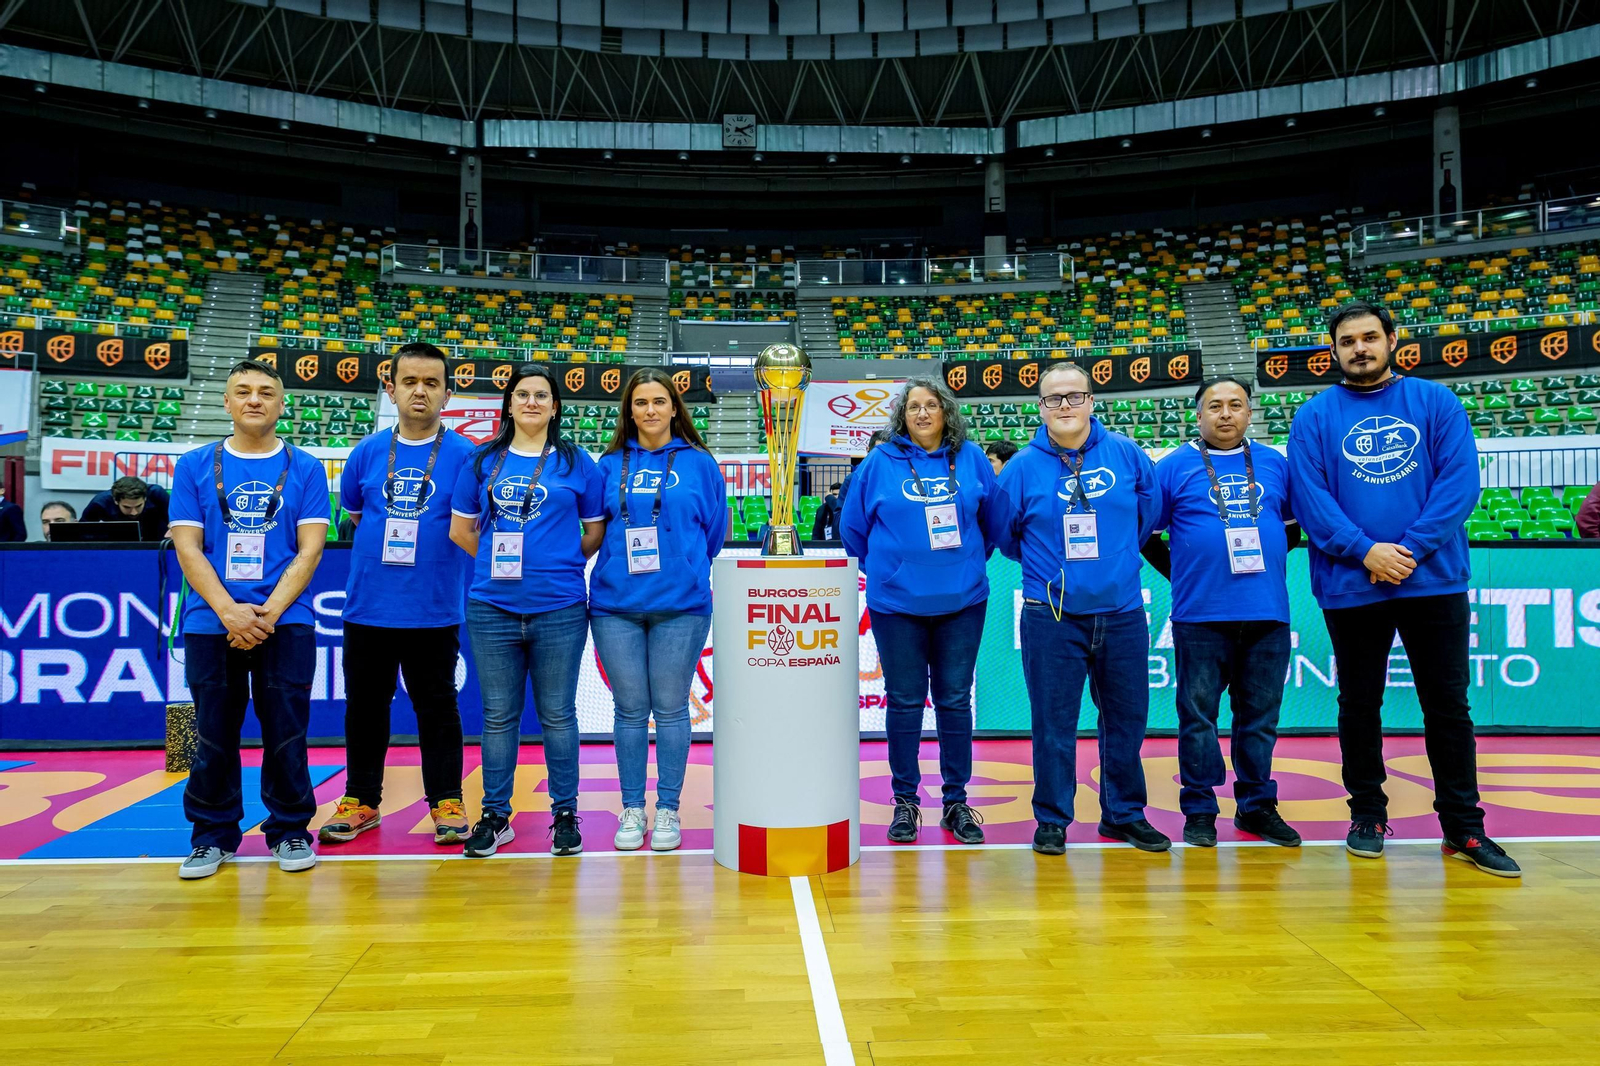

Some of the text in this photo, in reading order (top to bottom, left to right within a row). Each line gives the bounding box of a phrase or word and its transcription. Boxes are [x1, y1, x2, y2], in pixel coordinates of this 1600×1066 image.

[1440, 151, 1454, 169] F
[465, 192, 477, 207] E
[989, 196, 1001, 211] E
[830, 429, 876, 437] FIN
[52, 449, 174, 478] FINA
[748, 602, 840, 624] FINAL
[747, 653, 841, 667] COPA ESPAÑA
